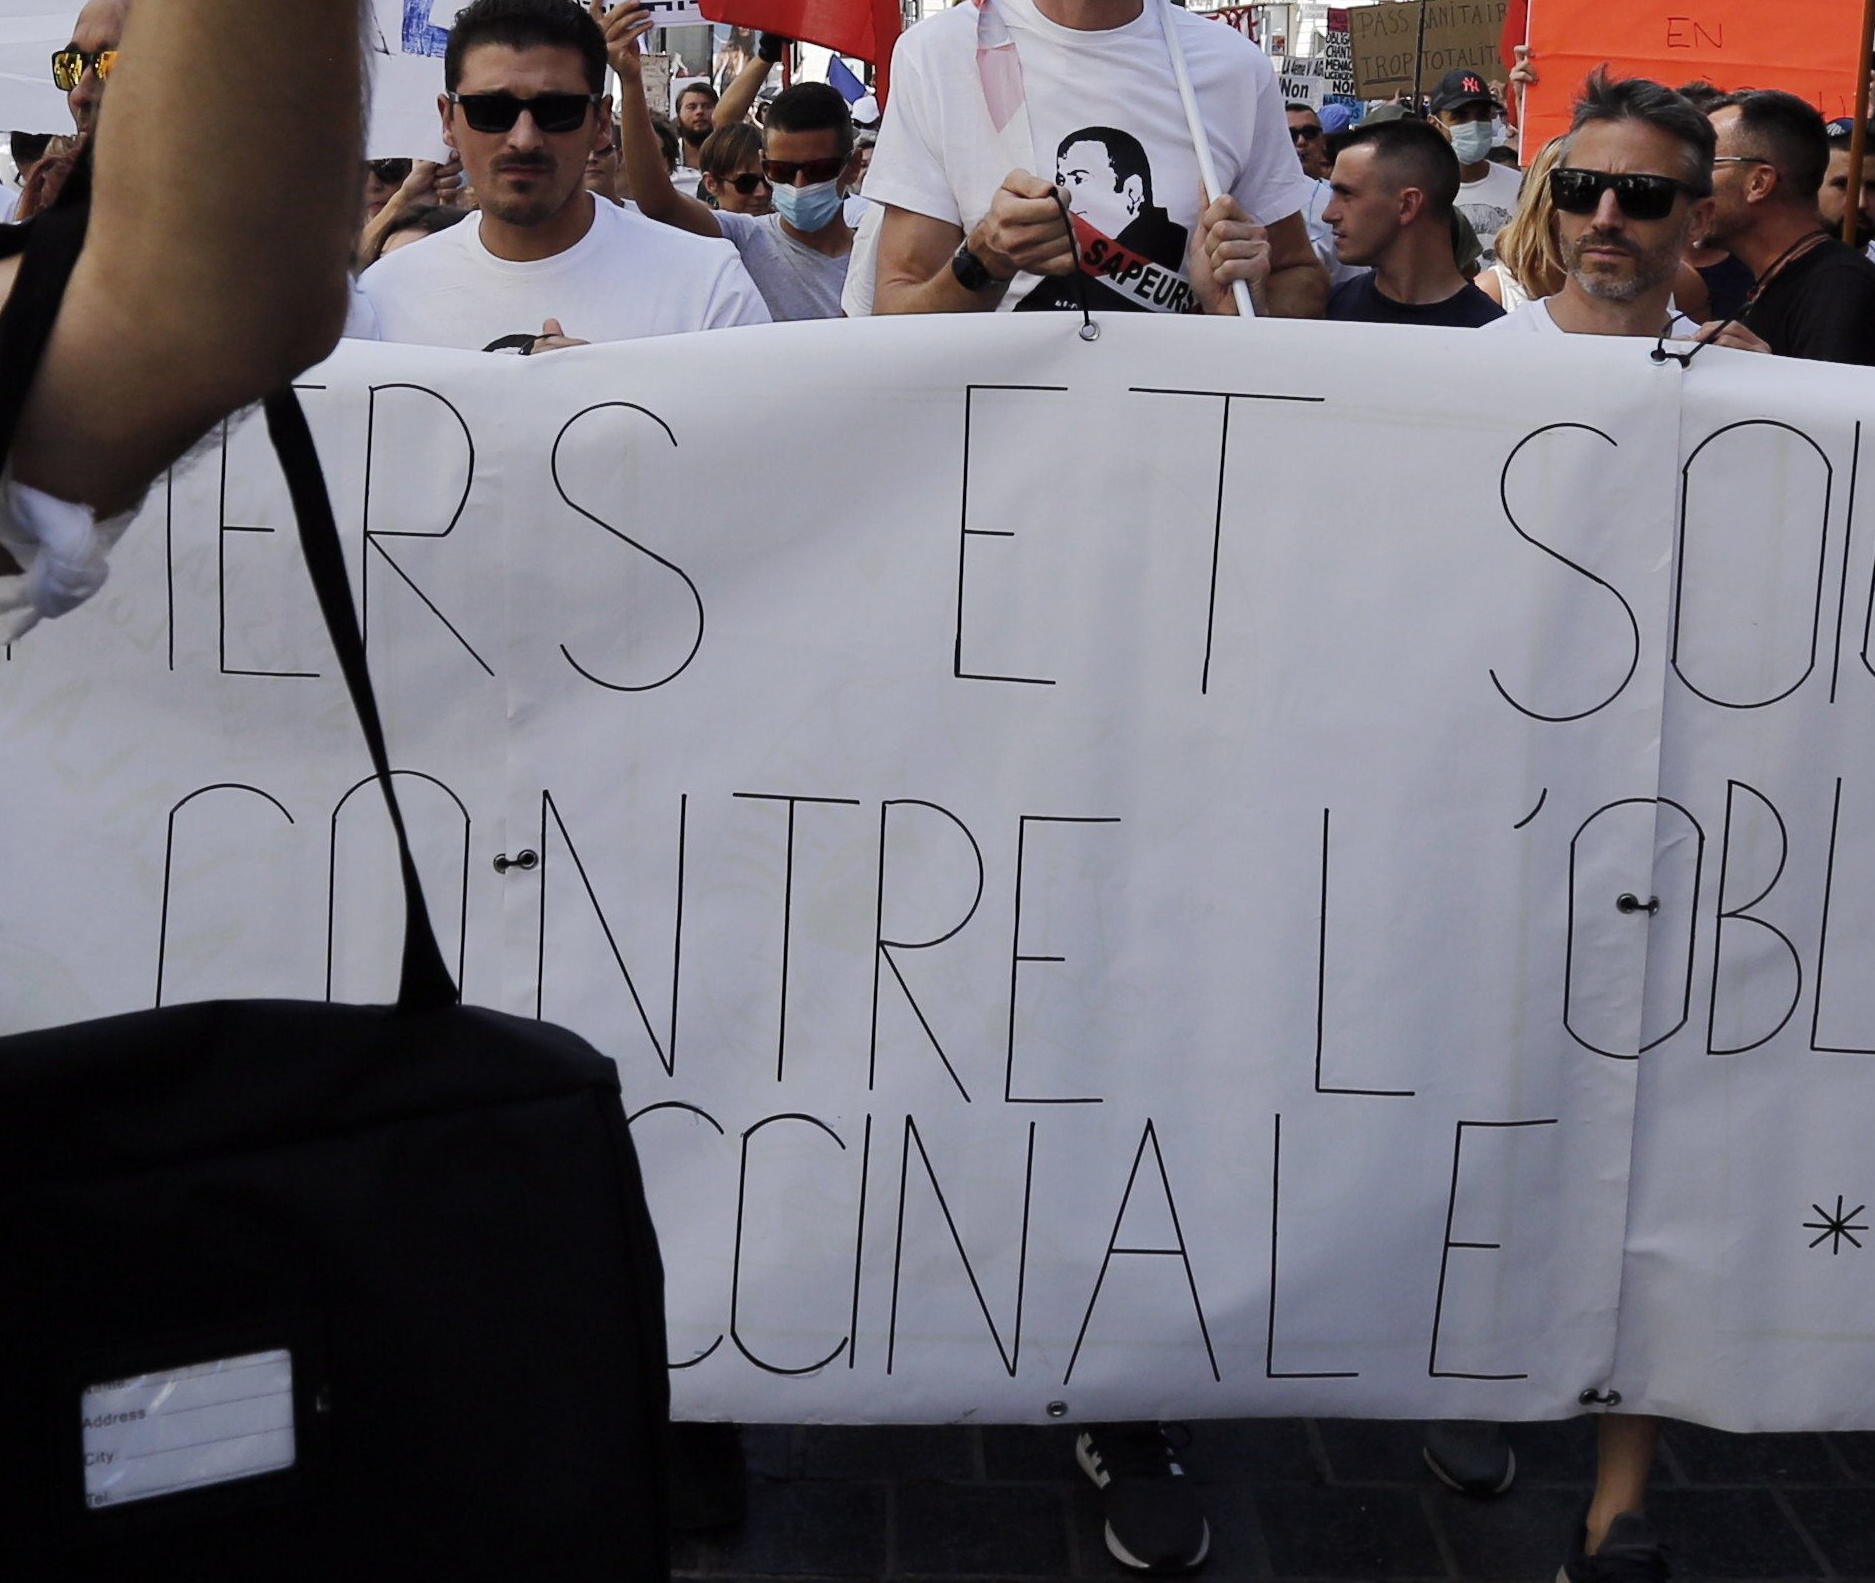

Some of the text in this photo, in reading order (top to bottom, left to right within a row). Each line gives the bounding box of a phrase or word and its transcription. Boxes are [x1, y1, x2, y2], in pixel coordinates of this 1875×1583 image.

[1357, 8, 1409, 39] PASS
[1667, 17, 1723, 49] EN
[1361, 52, 1414, 80] TROP
[1083, 238, 1195, 313] SAPEURS
[953, 382, 1326, 695] ET
[82, 1407, 147, 1430] Address
[85, 1448, 115, 1468] City
